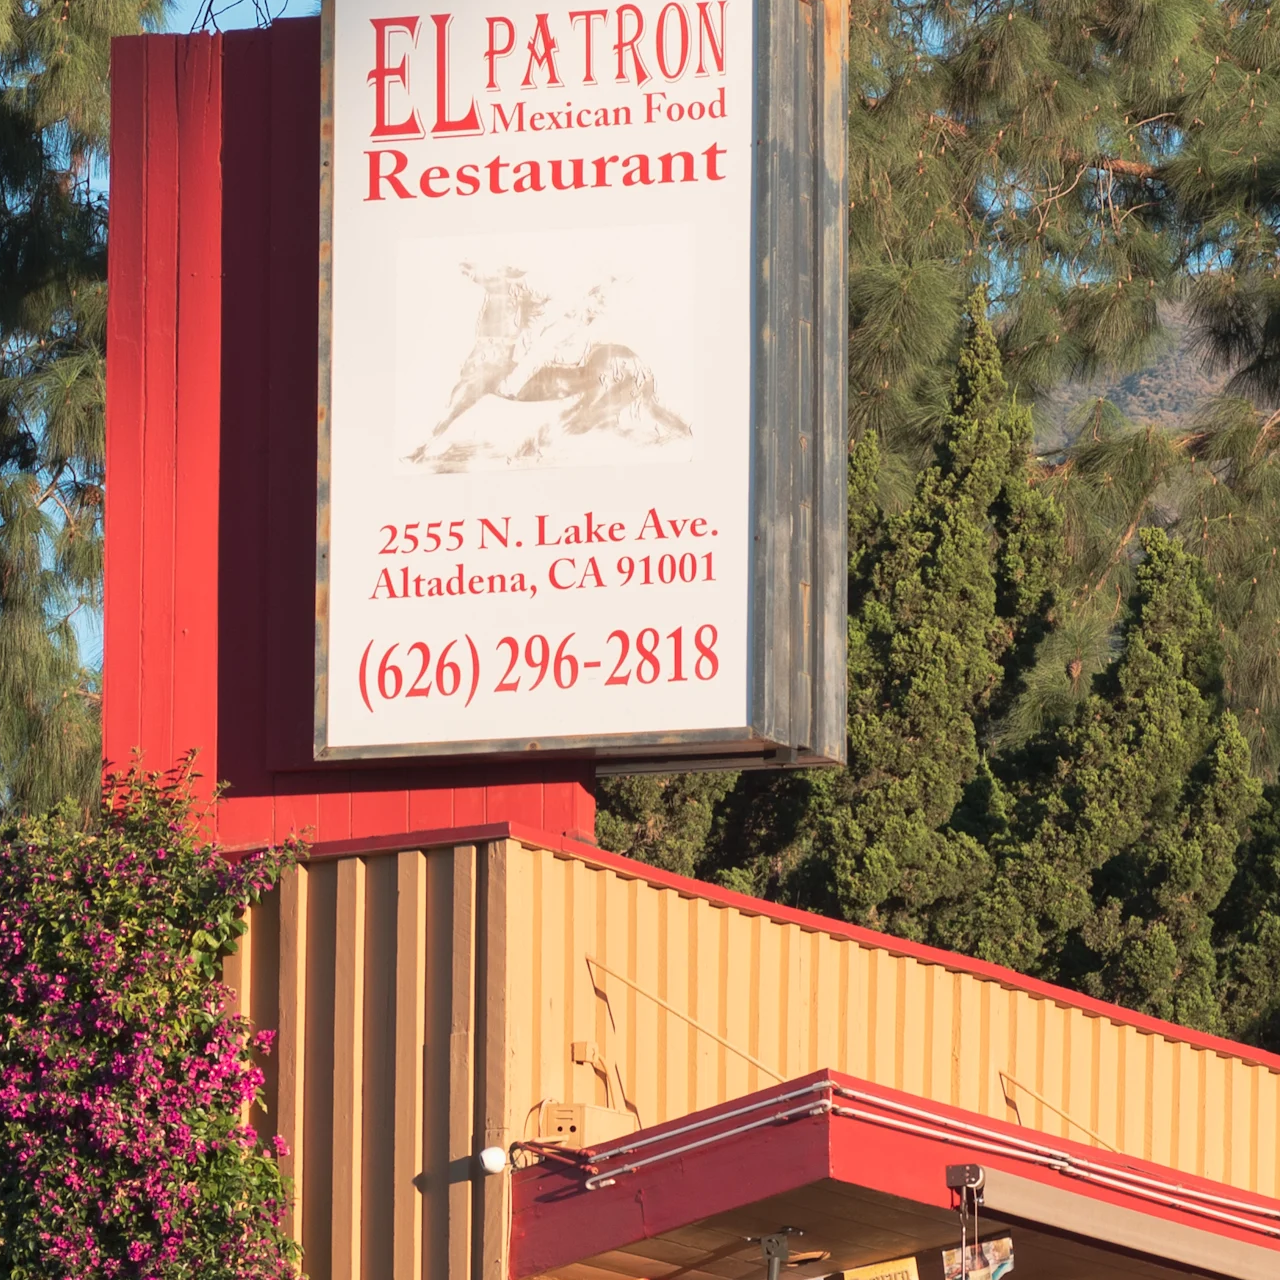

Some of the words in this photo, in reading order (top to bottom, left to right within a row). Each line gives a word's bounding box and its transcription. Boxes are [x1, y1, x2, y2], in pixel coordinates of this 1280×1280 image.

[367, 13, 485, 143] EL
[483, 0, 728, 92] PATRON
[490, 101, 632, 134] Mexican
[644, 86, 728, 124] Food
[363, 141, 728, 202] Restaurant
[379, 520, 465, 555] 2555
[479, 516, 523, 550] N.
[536, 511, 626, 546] Lake
[636, 507, 719, 541] Ave.
[370, 563, 538, 601] Altadena,
[547, 556, 606, 591] CA
[616, 551, 715, 586] 91001
[358, 634, 481, 713] (626)
[493, 623, 720, 693] 296-2818
